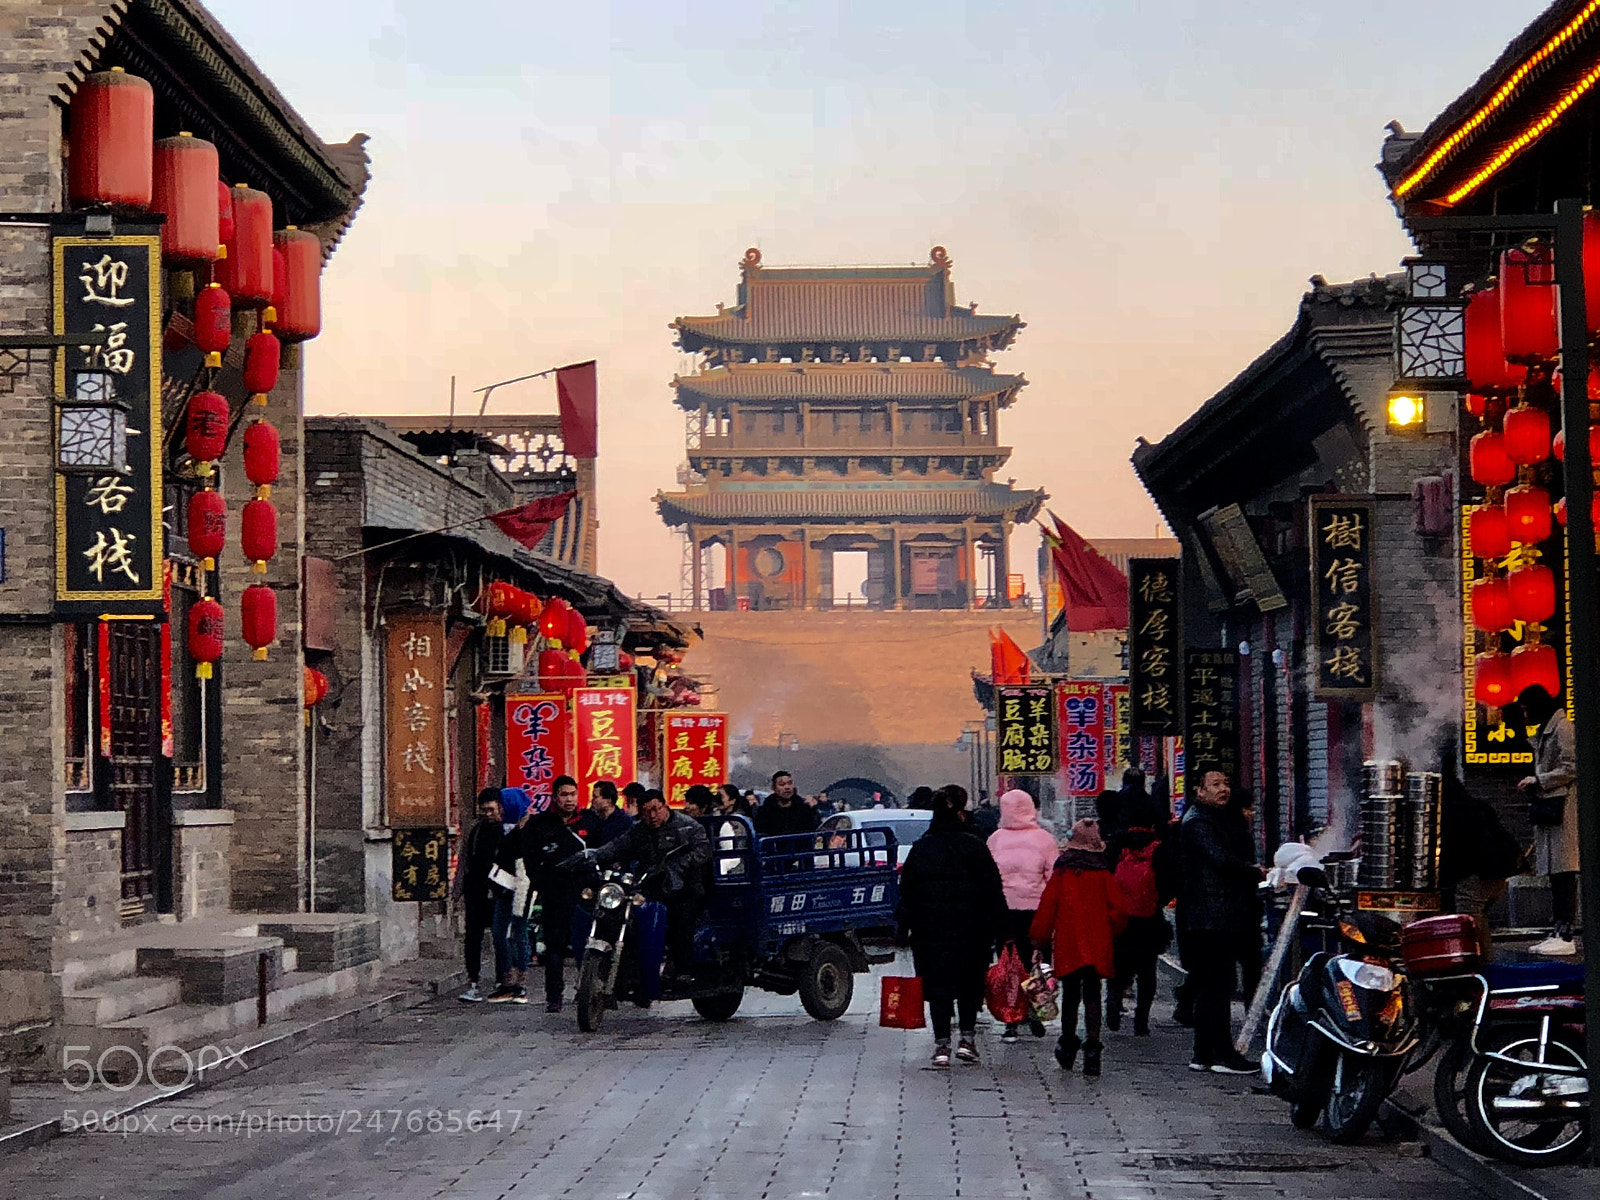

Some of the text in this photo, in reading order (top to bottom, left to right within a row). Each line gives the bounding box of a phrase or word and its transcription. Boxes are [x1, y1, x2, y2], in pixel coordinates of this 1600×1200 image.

[78, 254, 140, 584] 迎福客栈
[580, 693, 629, 706] 祖传
[1001, 699, 1027, 771] 豆腐脑
[1028, 697, 1052, 771] 羊杂汤
[1190, 667, 1219, 771] 平遥土特产
[585, 710, 624, 809] 豆腐
[1065, 696, 1098, 791] 羊杂汤
[401, 840, 439, 861] 今日
[770, 894, 806, 913] 福田
[851, 885, 885, 904] 五星
